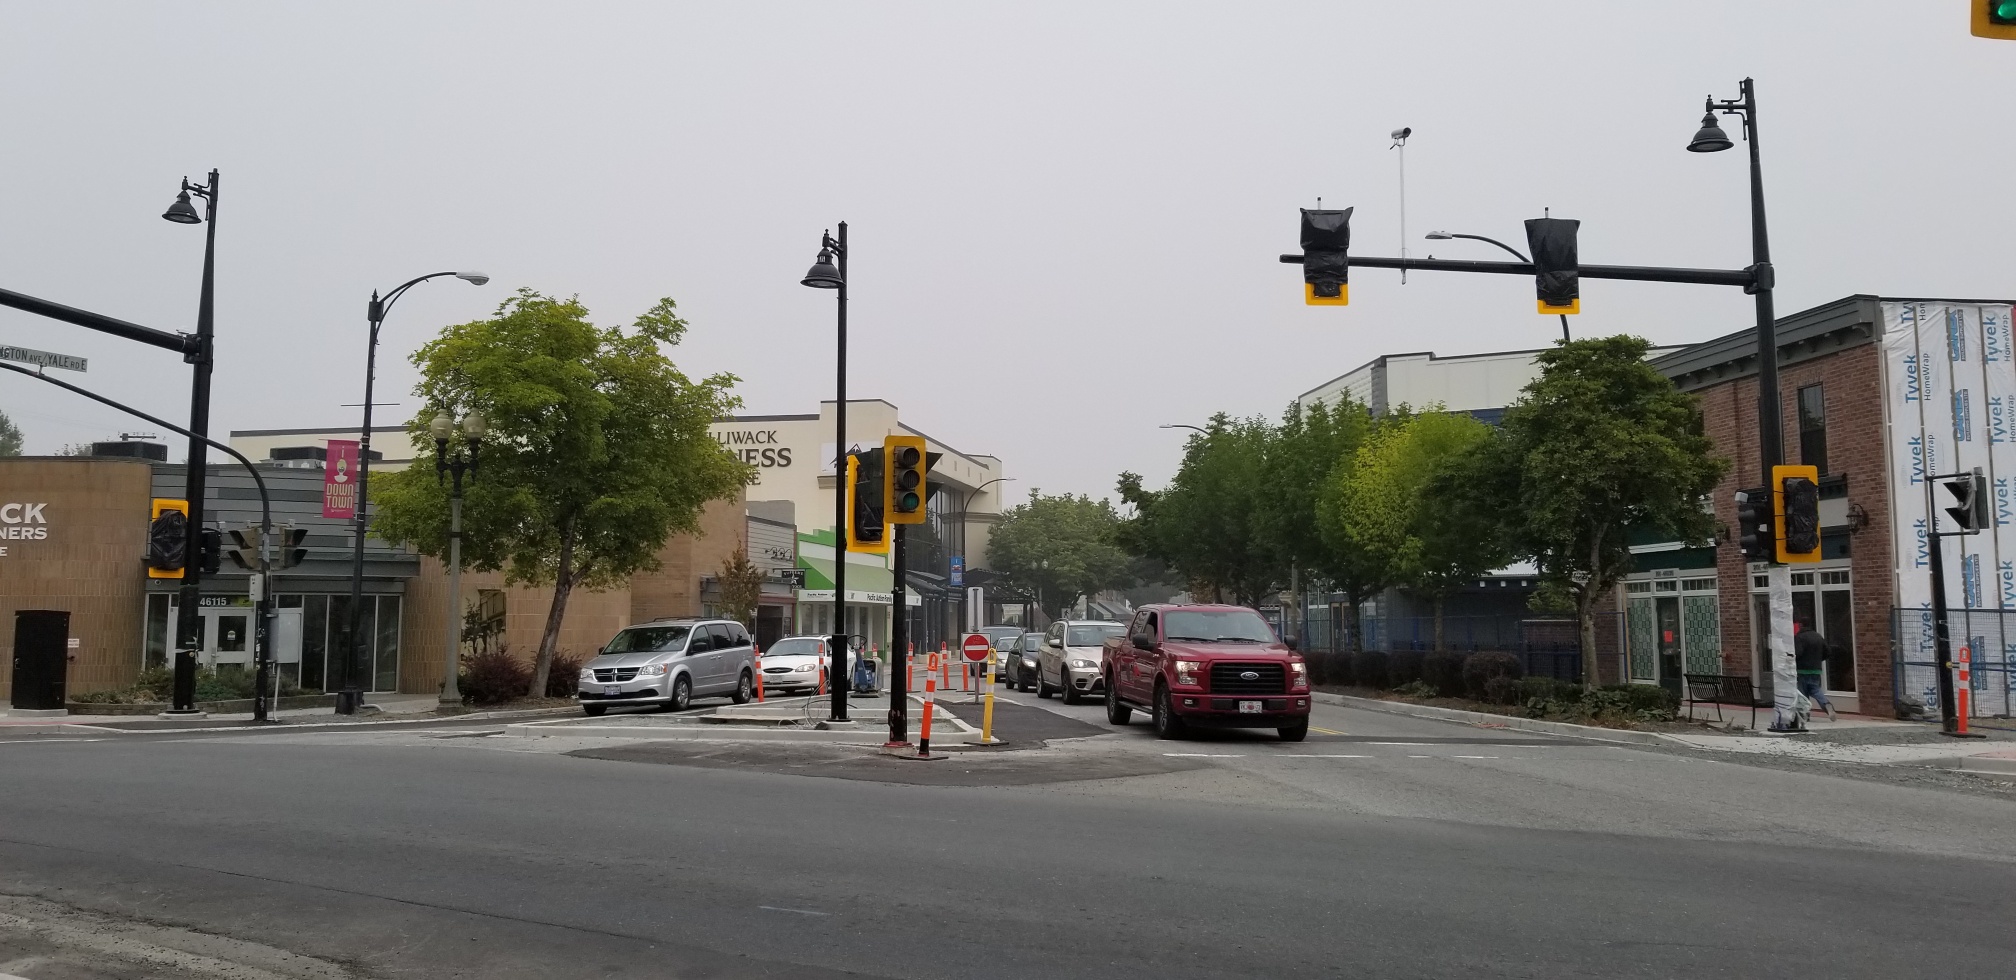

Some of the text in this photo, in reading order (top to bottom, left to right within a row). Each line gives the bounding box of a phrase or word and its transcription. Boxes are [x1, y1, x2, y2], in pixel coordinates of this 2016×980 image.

[1983, 316, 2002, 365] Tyvek
[2001, 314, 2011, 362] HomeWrap
[81, 359, 87, 371] E
[1903, 354, 1919, 404] Tyvek
[1922, 353, 1931, 401] HomeWrap
[1989, 396, 2007, 446] Tyvek
[2007, 394, 2016, 443] HomeWrap
[1908, 436, 1925, 486] Tyvek
[0, 502, 48, 524] CK
[326, 483, 354, 496] DOWN
[326, 495, 353, 509] TOWN
[1993, 477, 2013, 528] Tyvek
[1913, 518, 1930, 569] Tyvek
[199, 597, 227, 606] 46115
[1999, 559, 2016, 609] Tyvek
